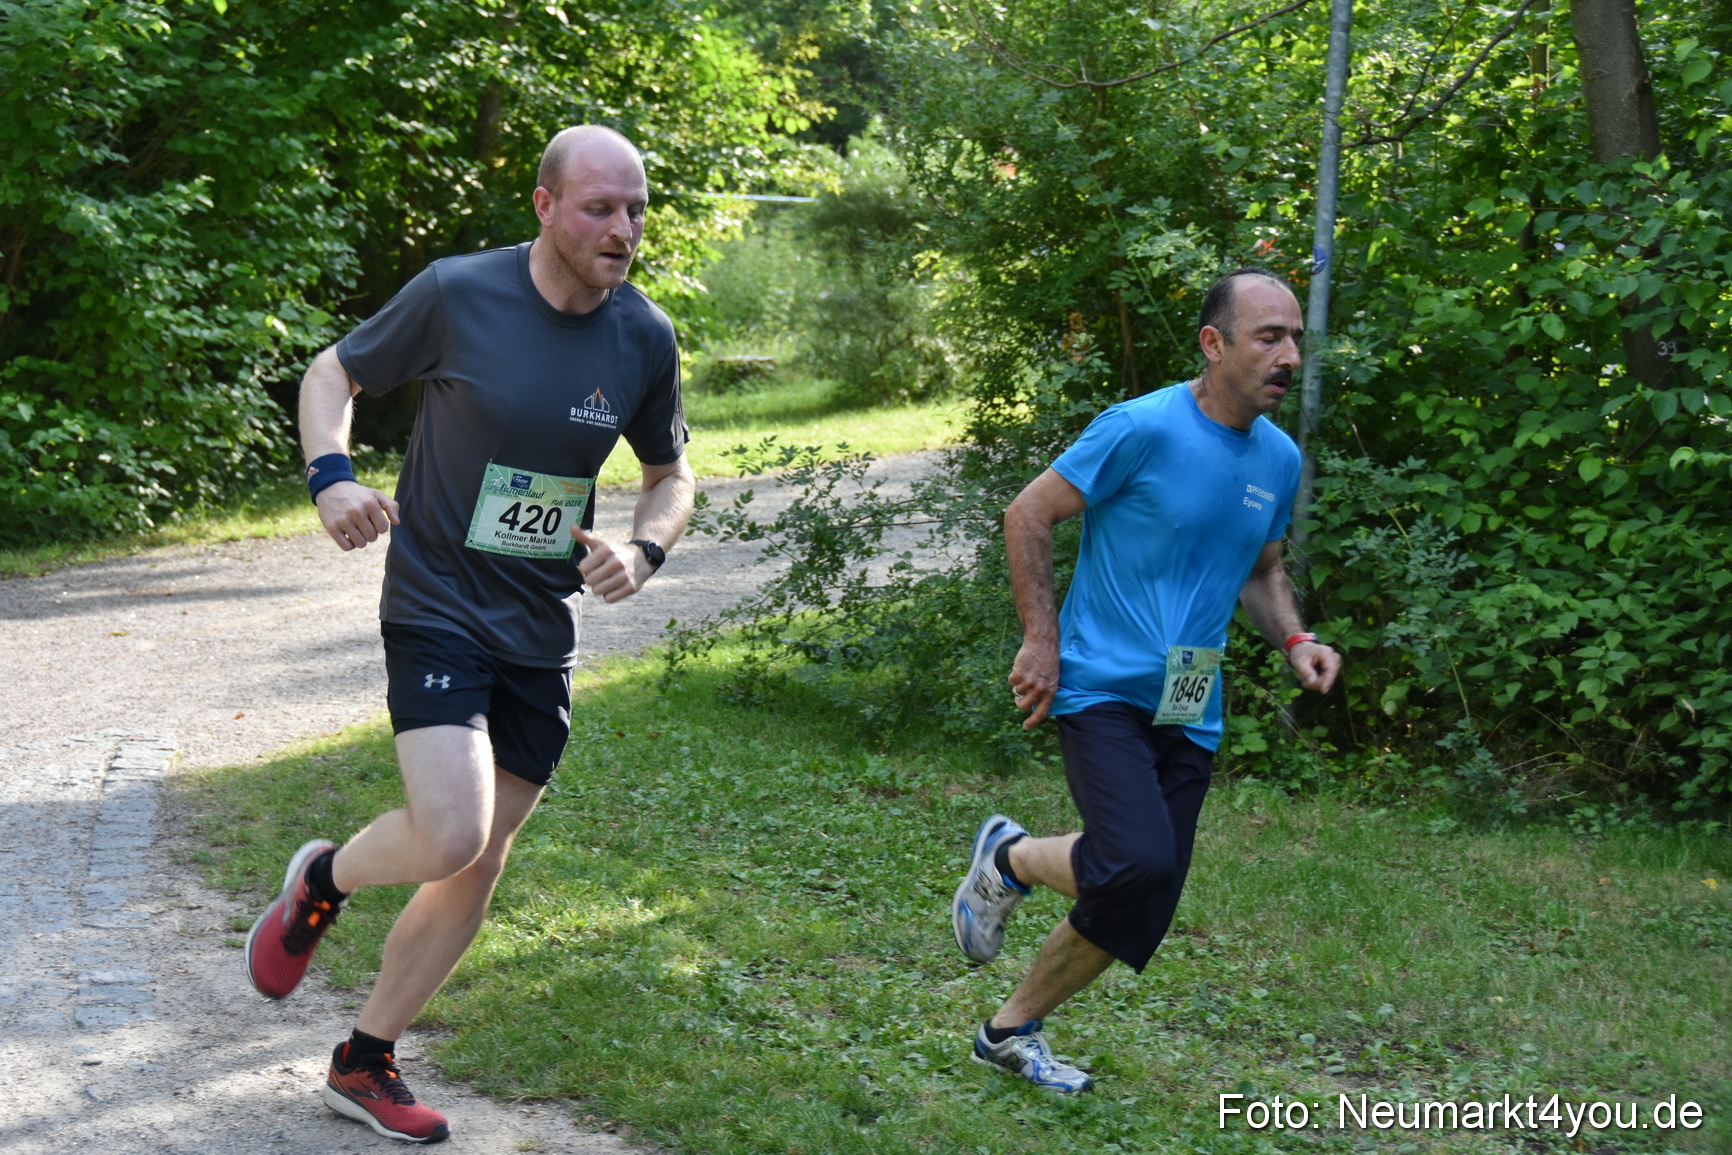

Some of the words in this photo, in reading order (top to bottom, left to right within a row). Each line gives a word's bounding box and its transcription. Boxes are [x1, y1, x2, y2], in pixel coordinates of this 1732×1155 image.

[570, 407, 618, 424] BURKHARDT
[565, 499, 582, 507] 2019
[498, 501, 562, 536] 420
[494, 530, 528, 543] Kollmer
[528, 535, 557, 545] Markus
[501, 540, 529, 549] Burkhardt
[1169, 676, 1208, 703] 1846
